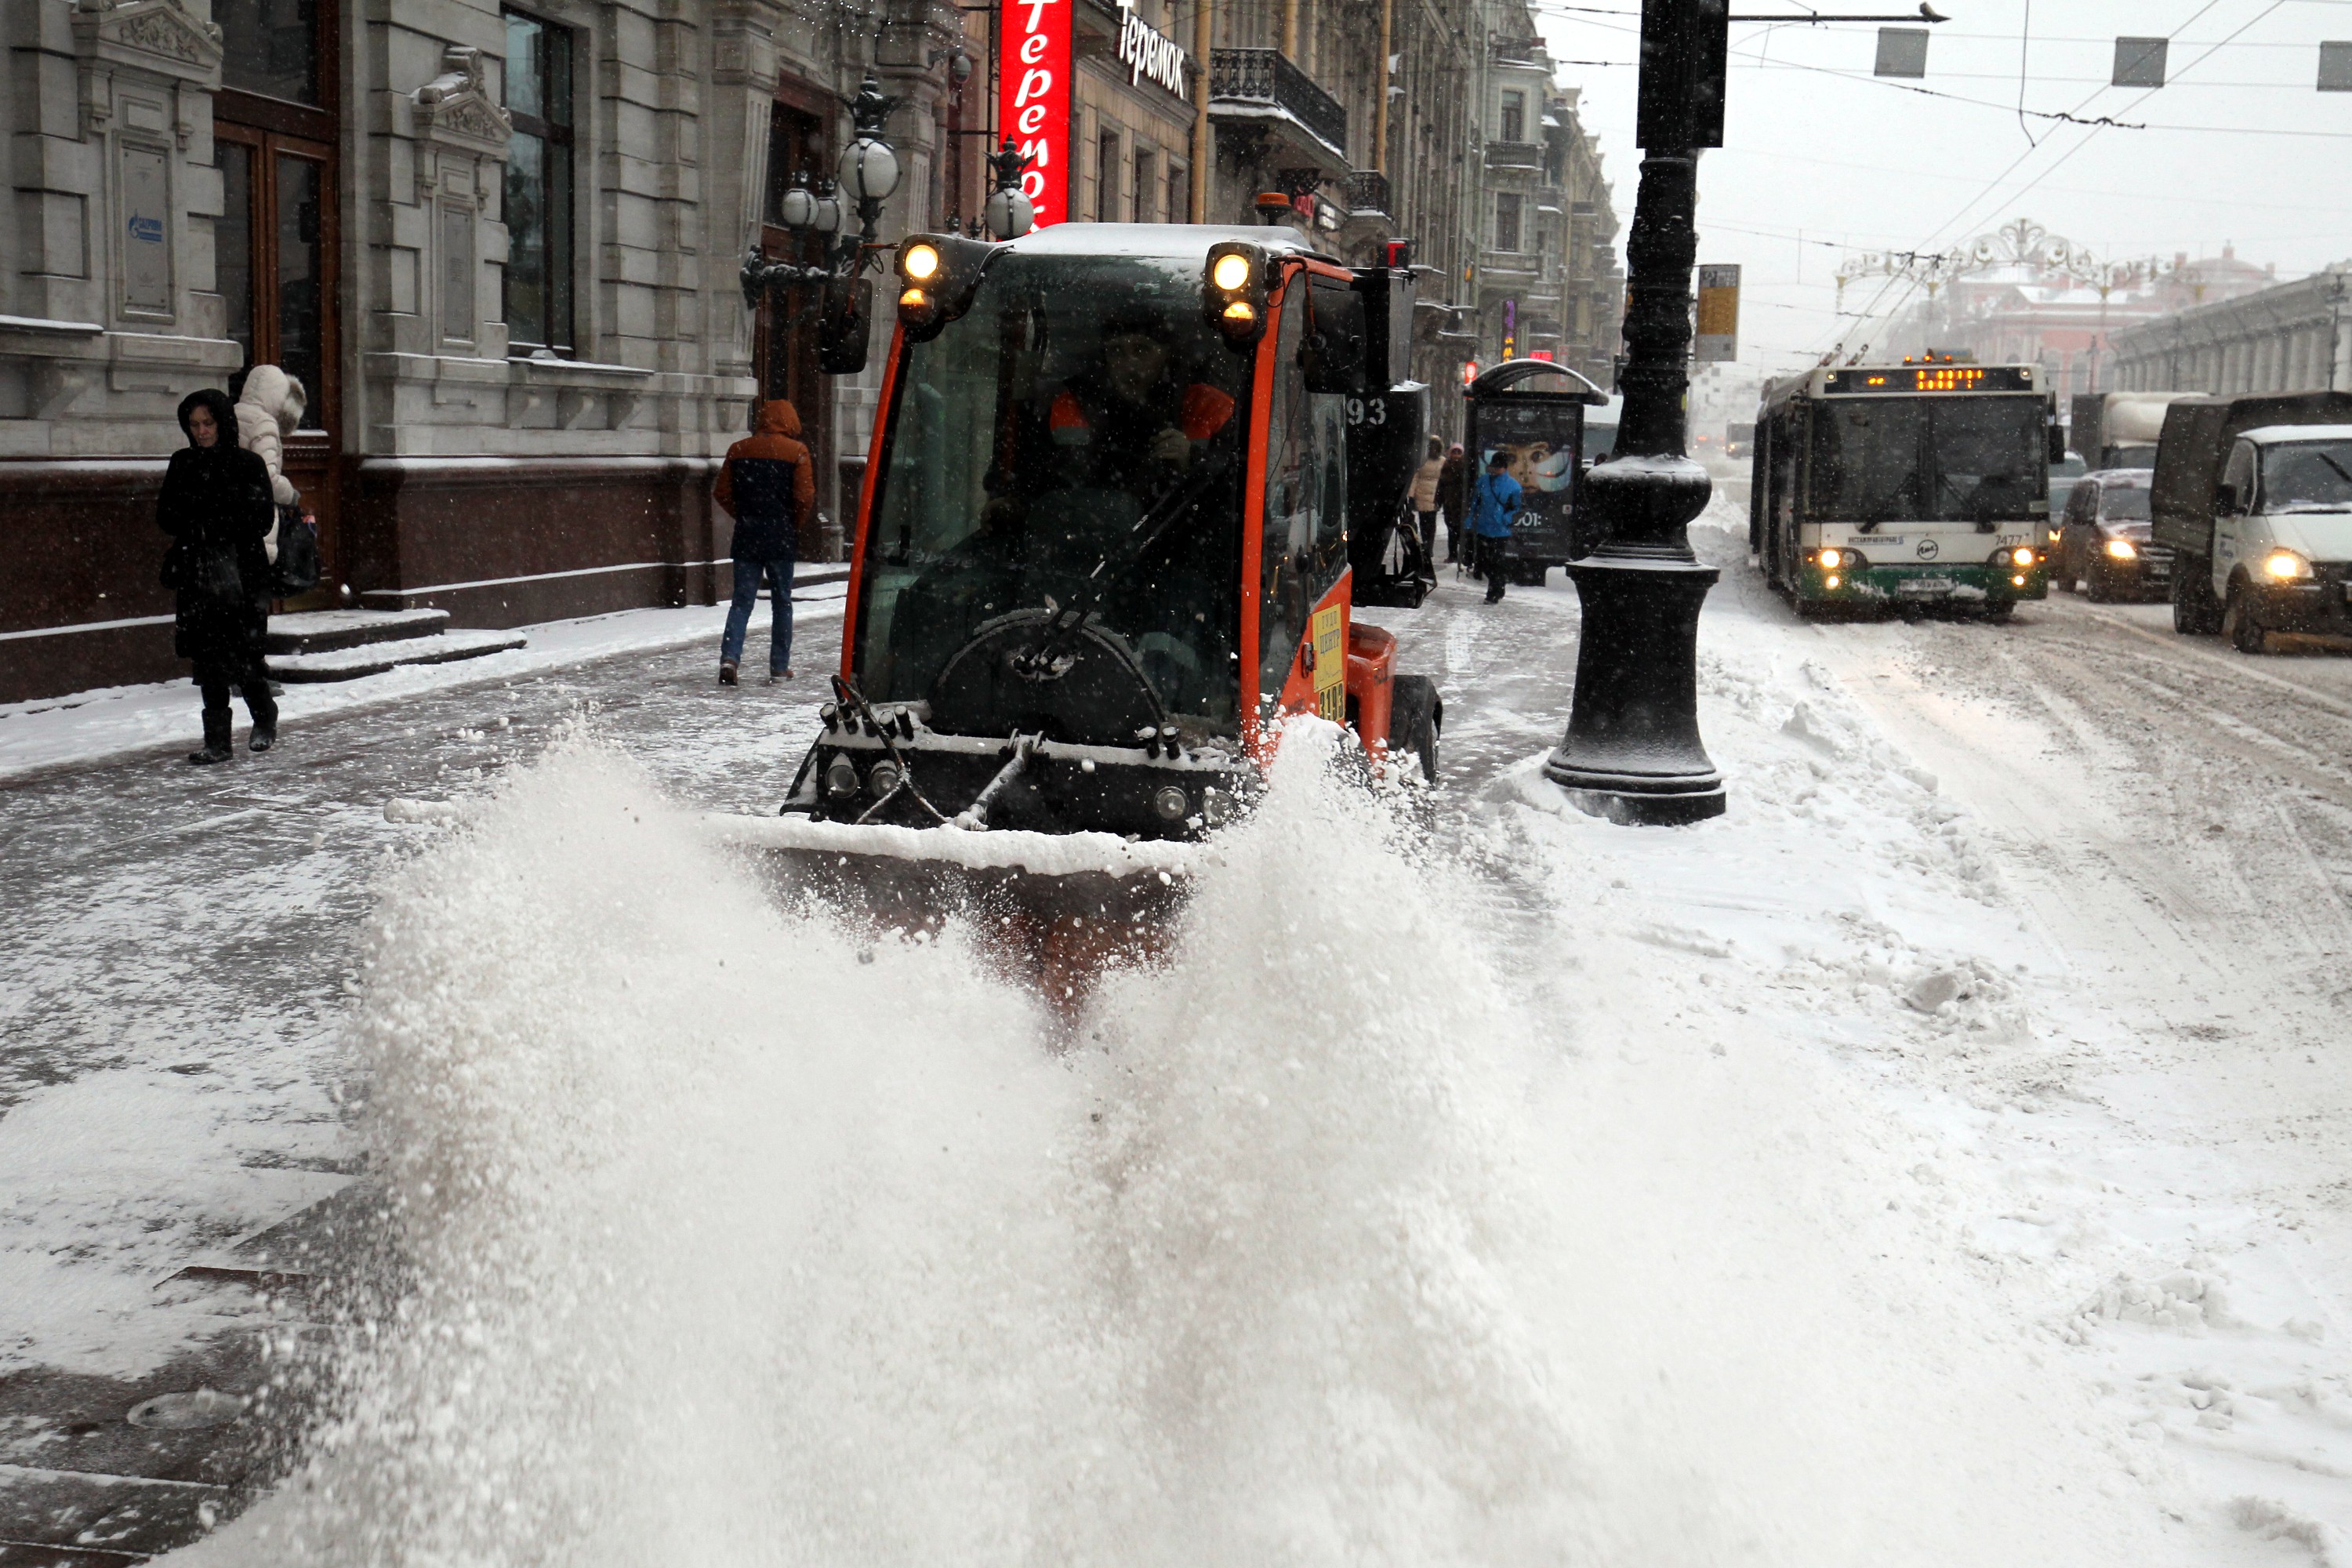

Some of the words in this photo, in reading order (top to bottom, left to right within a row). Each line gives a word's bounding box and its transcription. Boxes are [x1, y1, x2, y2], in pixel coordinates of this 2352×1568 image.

[1116, 0, 1184, 100] Теремок
[1994, 534, 2023, 546] 7477
[1319, 628, 1340, 655] ЦЕНТР
[1319, 683, 1343, 720] 3193
